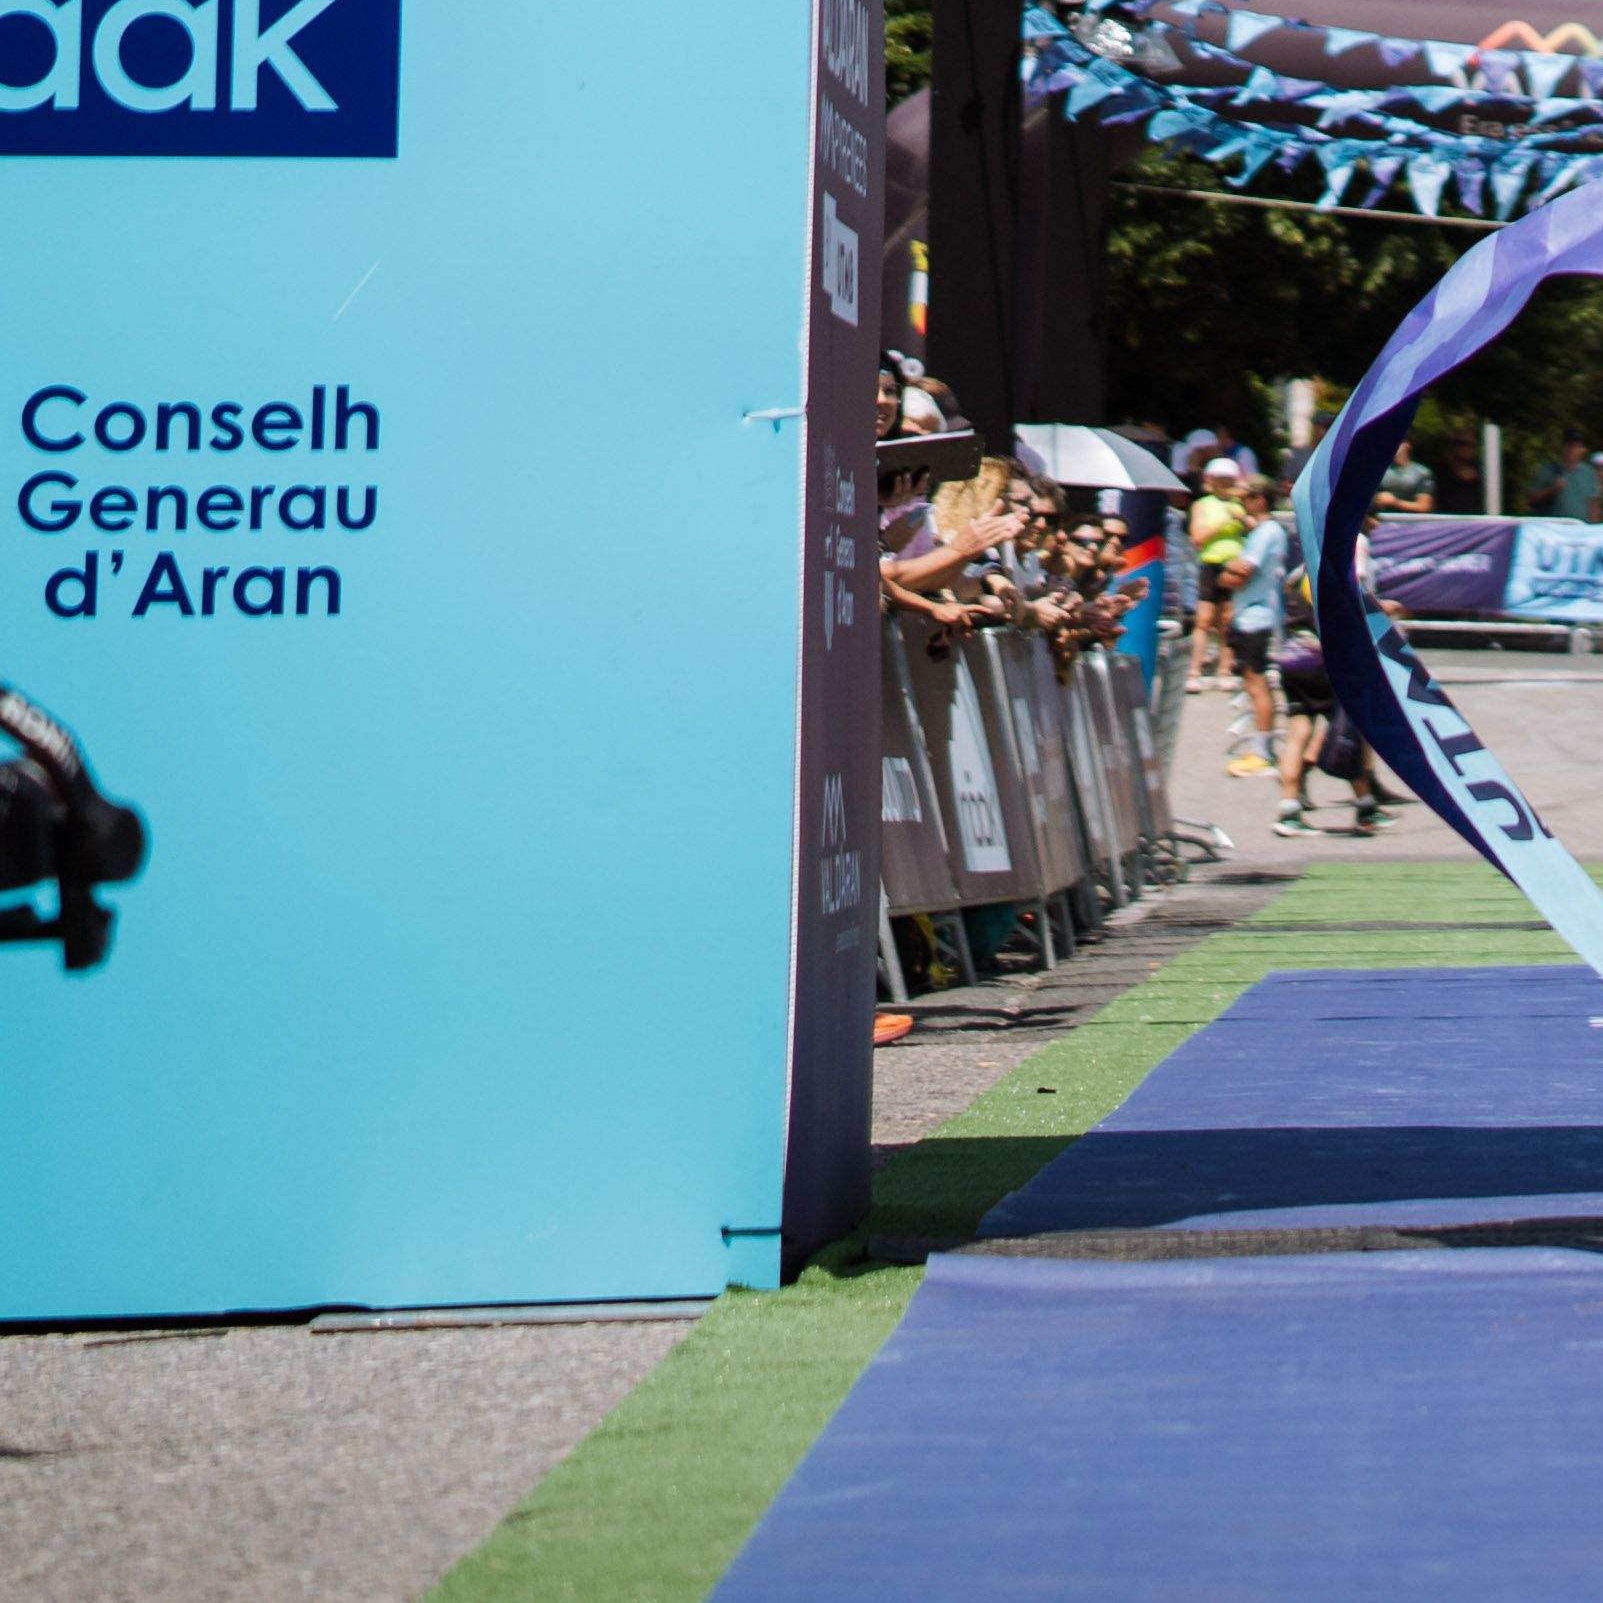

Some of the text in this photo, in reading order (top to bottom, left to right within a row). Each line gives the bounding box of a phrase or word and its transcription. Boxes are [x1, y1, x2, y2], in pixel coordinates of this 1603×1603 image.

[21, 384, 381, 453] Conselh
[17, 470, 379, 532] Generau
[43, 551, 343, 618] d'Aran
